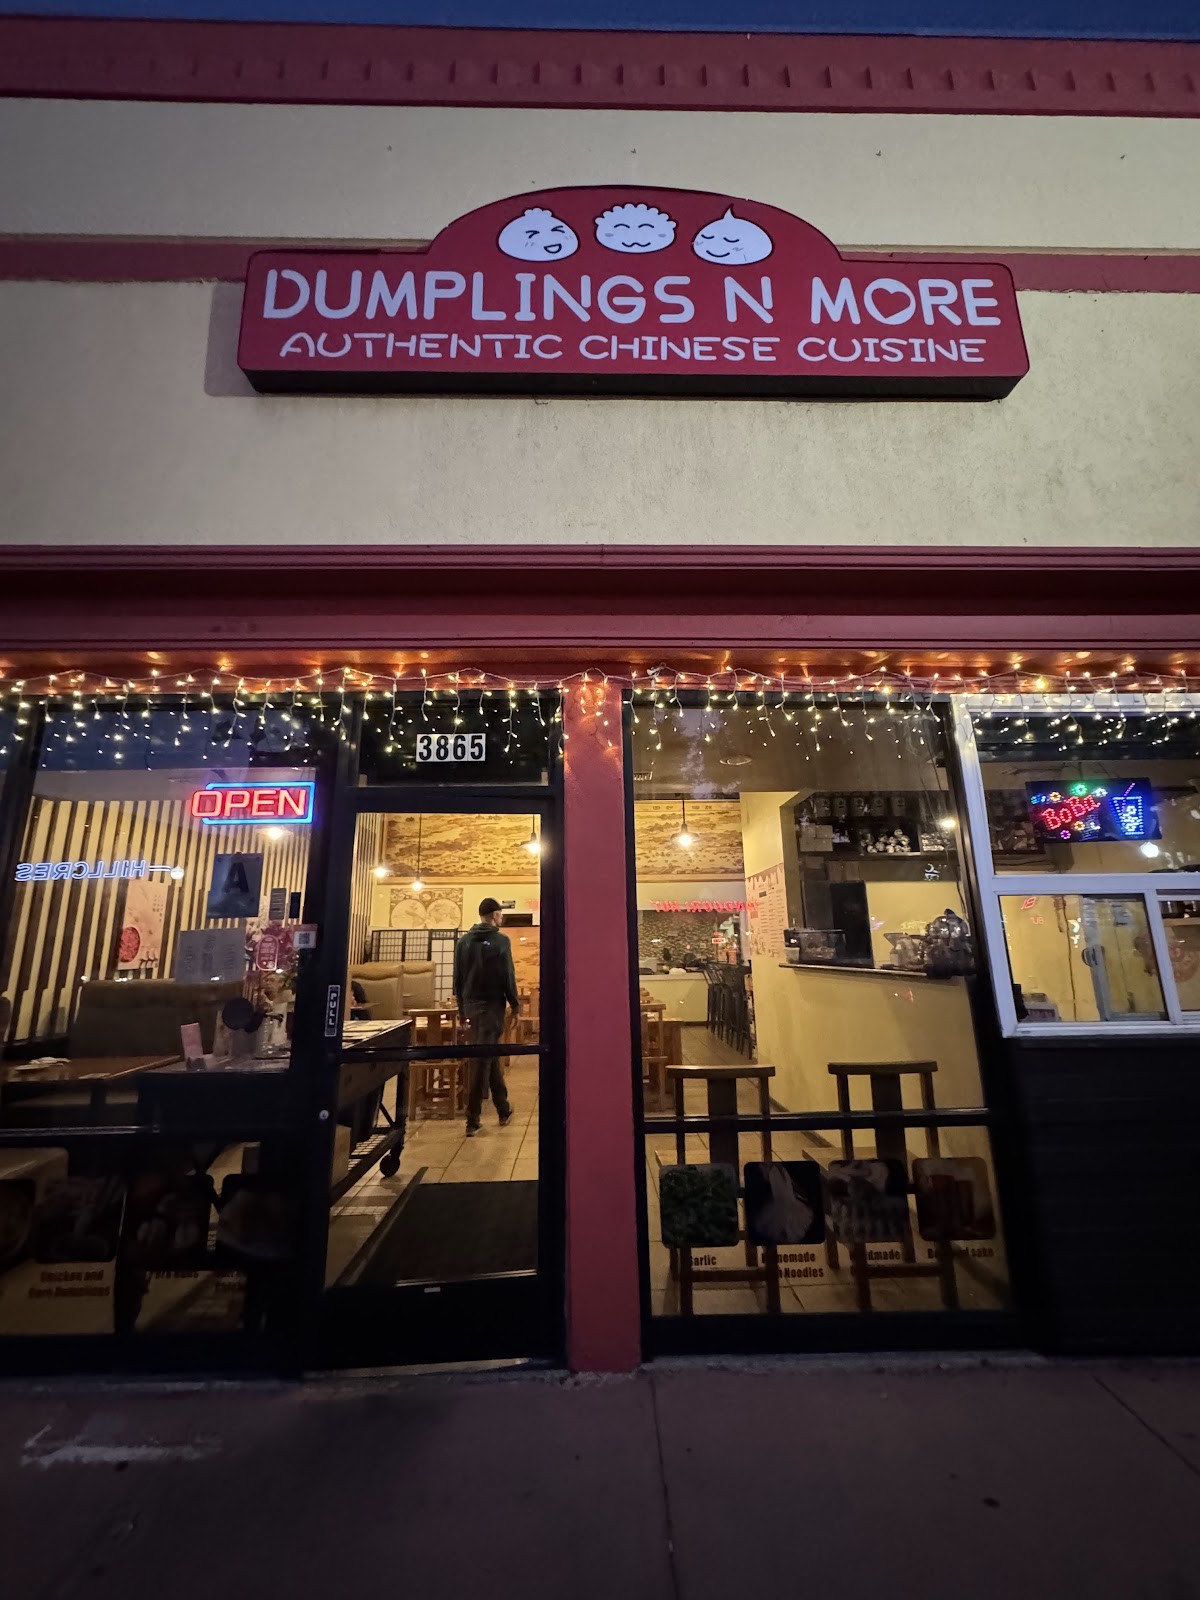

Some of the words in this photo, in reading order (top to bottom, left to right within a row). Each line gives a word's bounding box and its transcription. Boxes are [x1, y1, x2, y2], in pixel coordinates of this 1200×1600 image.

[263, 269, 695, 324] DUMPLINGS
[724, 276, 774, 324] N
[811, 278, 1001, 326] MORE
[279, 332, 563, 359] AUTHENTIC
[579, 334, 780, 361] CHINESE
[797, 338, 986, 363] CUISINE
[418, 734, 484, 761] 3865
[191, 789, 306, 817] OPEN
[328, 992, 338, 1026] PULL
